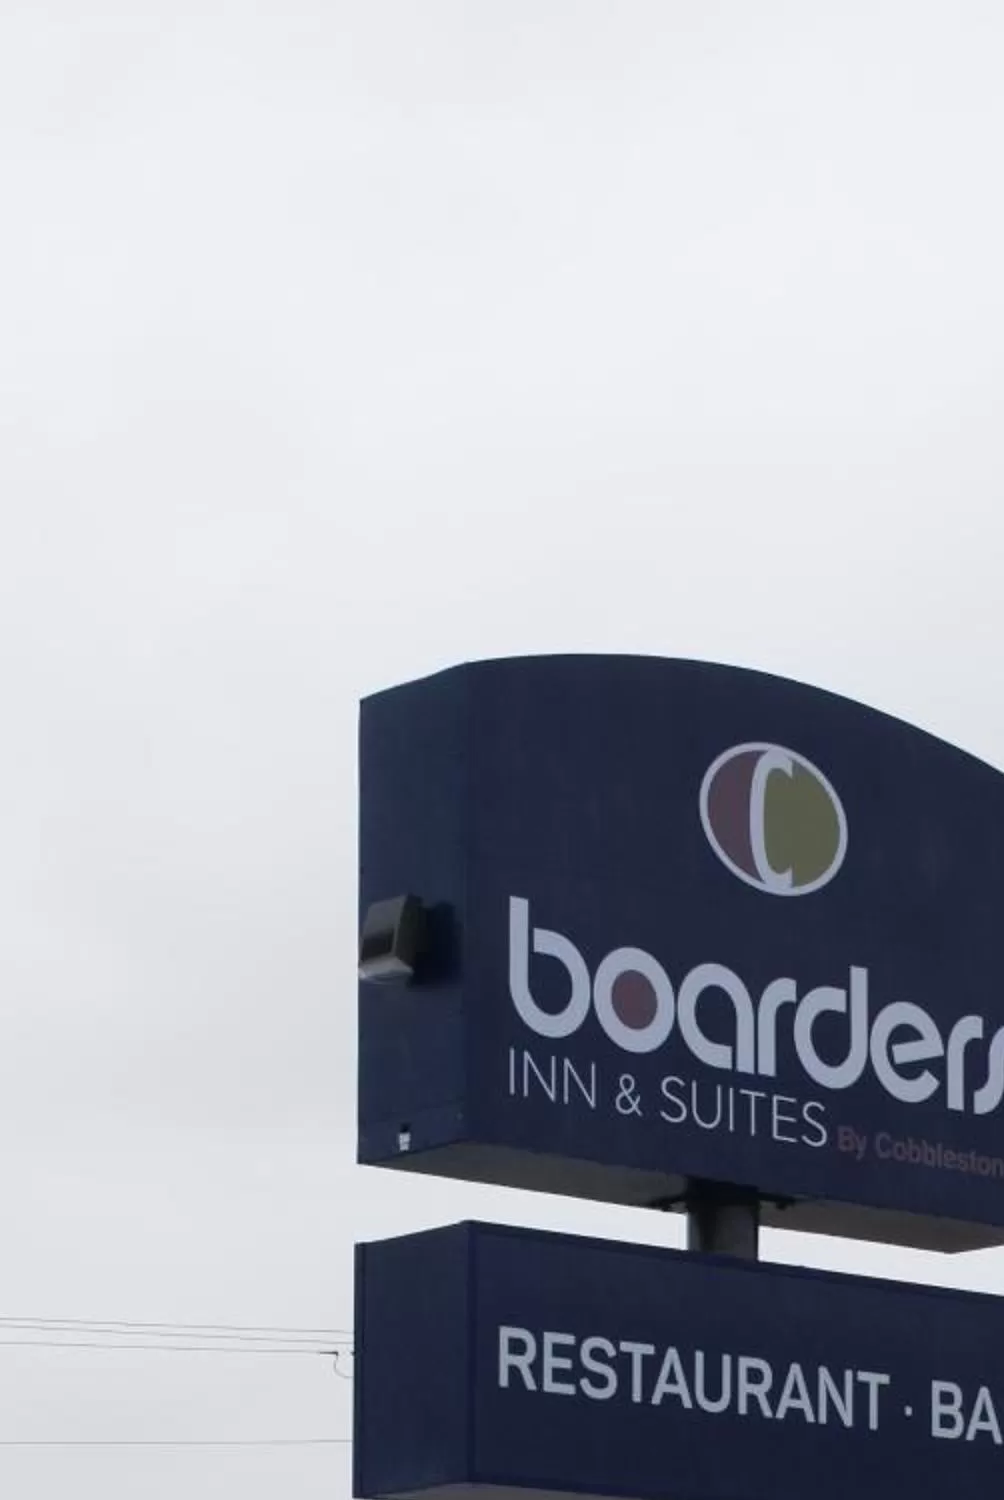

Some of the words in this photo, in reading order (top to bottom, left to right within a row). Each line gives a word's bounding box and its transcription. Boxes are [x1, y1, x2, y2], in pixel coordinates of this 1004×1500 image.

[509, 1047, 596, 1110] INN
[614, 1073, 643, 1117] &
[659, 1075, 828, 1148] SUITES
[837, 1125, 867, 1161] By
[499, 1325, 890, 1431] RESTAURANT
